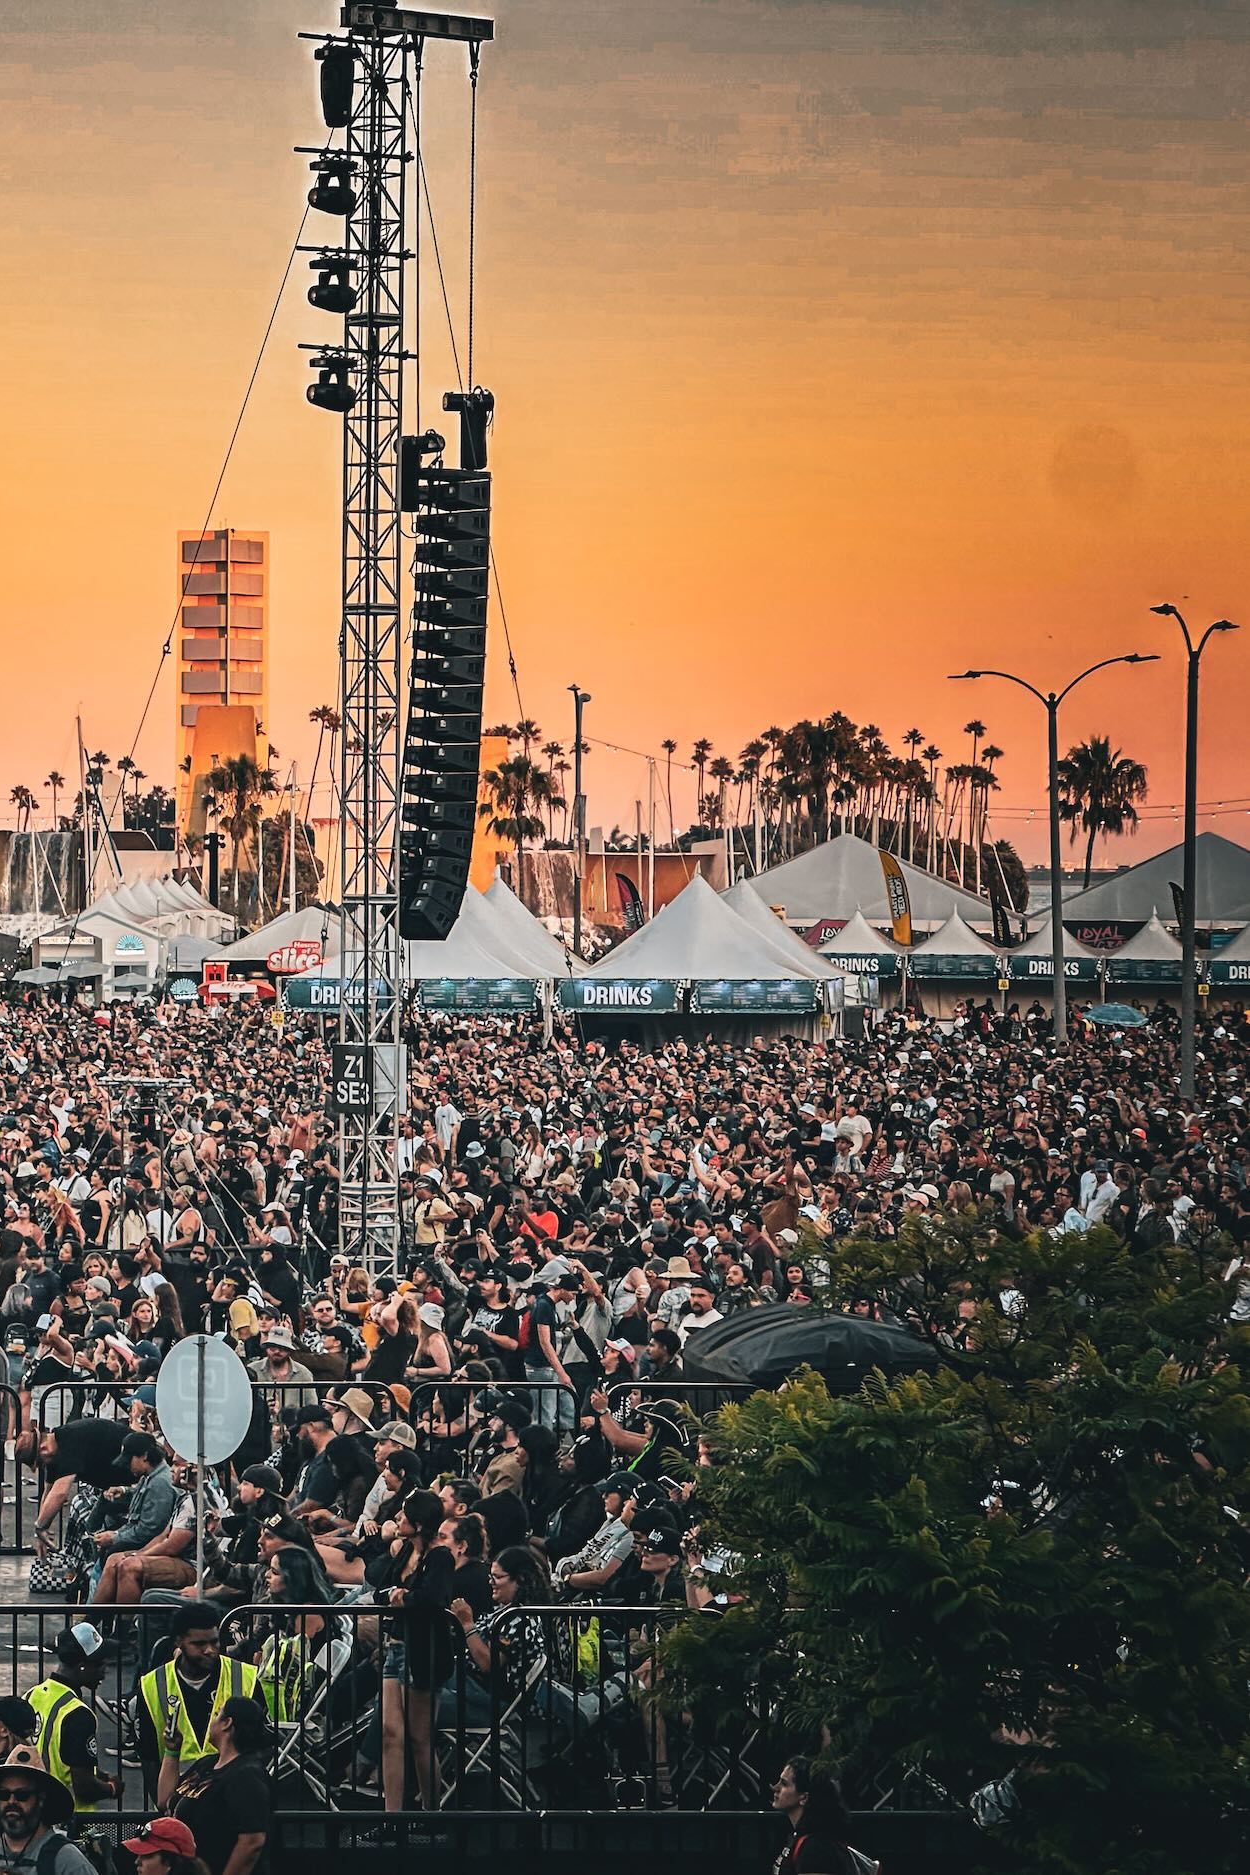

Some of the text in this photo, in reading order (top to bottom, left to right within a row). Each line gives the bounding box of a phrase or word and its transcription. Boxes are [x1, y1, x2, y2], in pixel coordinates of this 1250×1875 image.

[1076, 926, 1126, 943] LOYAL
[270, 948, 319, 970] slice
[1029, 961, 1080, 975] DRIKS
[583, 986, 652, 1006] DRINKS
[344, 1055, 364, 1079] Z1
